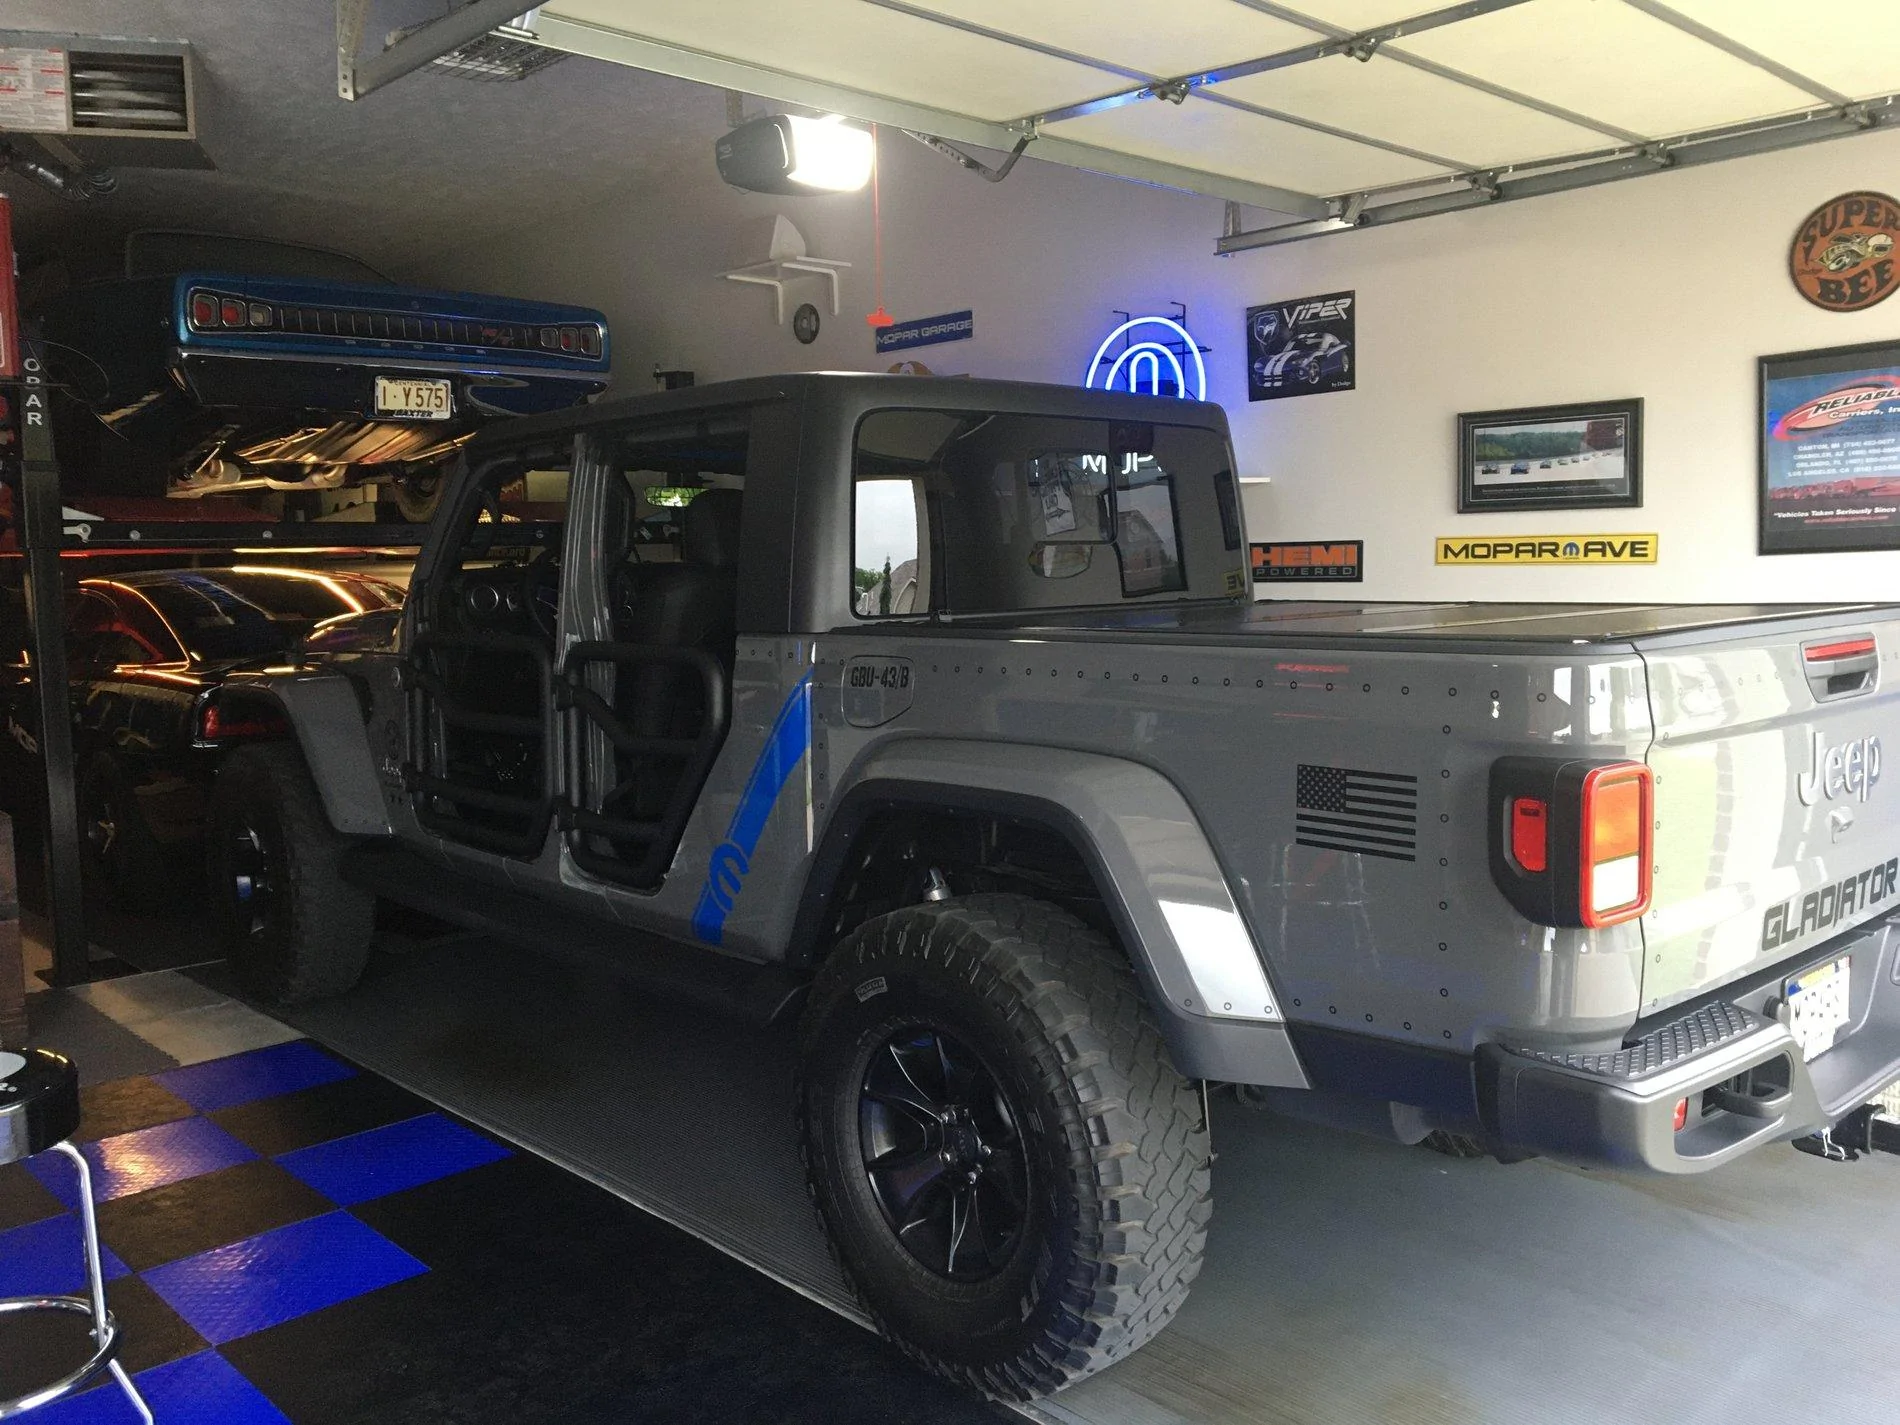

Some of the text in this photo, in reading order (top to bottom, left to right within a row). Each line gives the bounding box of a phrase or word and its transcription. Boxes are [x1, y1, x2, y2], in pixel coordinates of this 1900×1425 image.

[1801, 200, 1900, 265] SUPER
[1817, 259, 1893, 304] BEE
[1283, 298, 1352, 329] VIPER
[877, 319, 972, 346] MOPAR GARAGE
[1813, 389, 1900, 414] RELIABL
[1251, 543, 1357, 567] HEMI
[1443, 540, 1649, 559] MOPAR AVE
[1256, 567, 1352, 576] POWERED
[850, 664, 909, 690] GBU-43/B
[1798, 732, 1882, 807] Jeep
[1761, 857, 1898, 952] GLADIATOR
